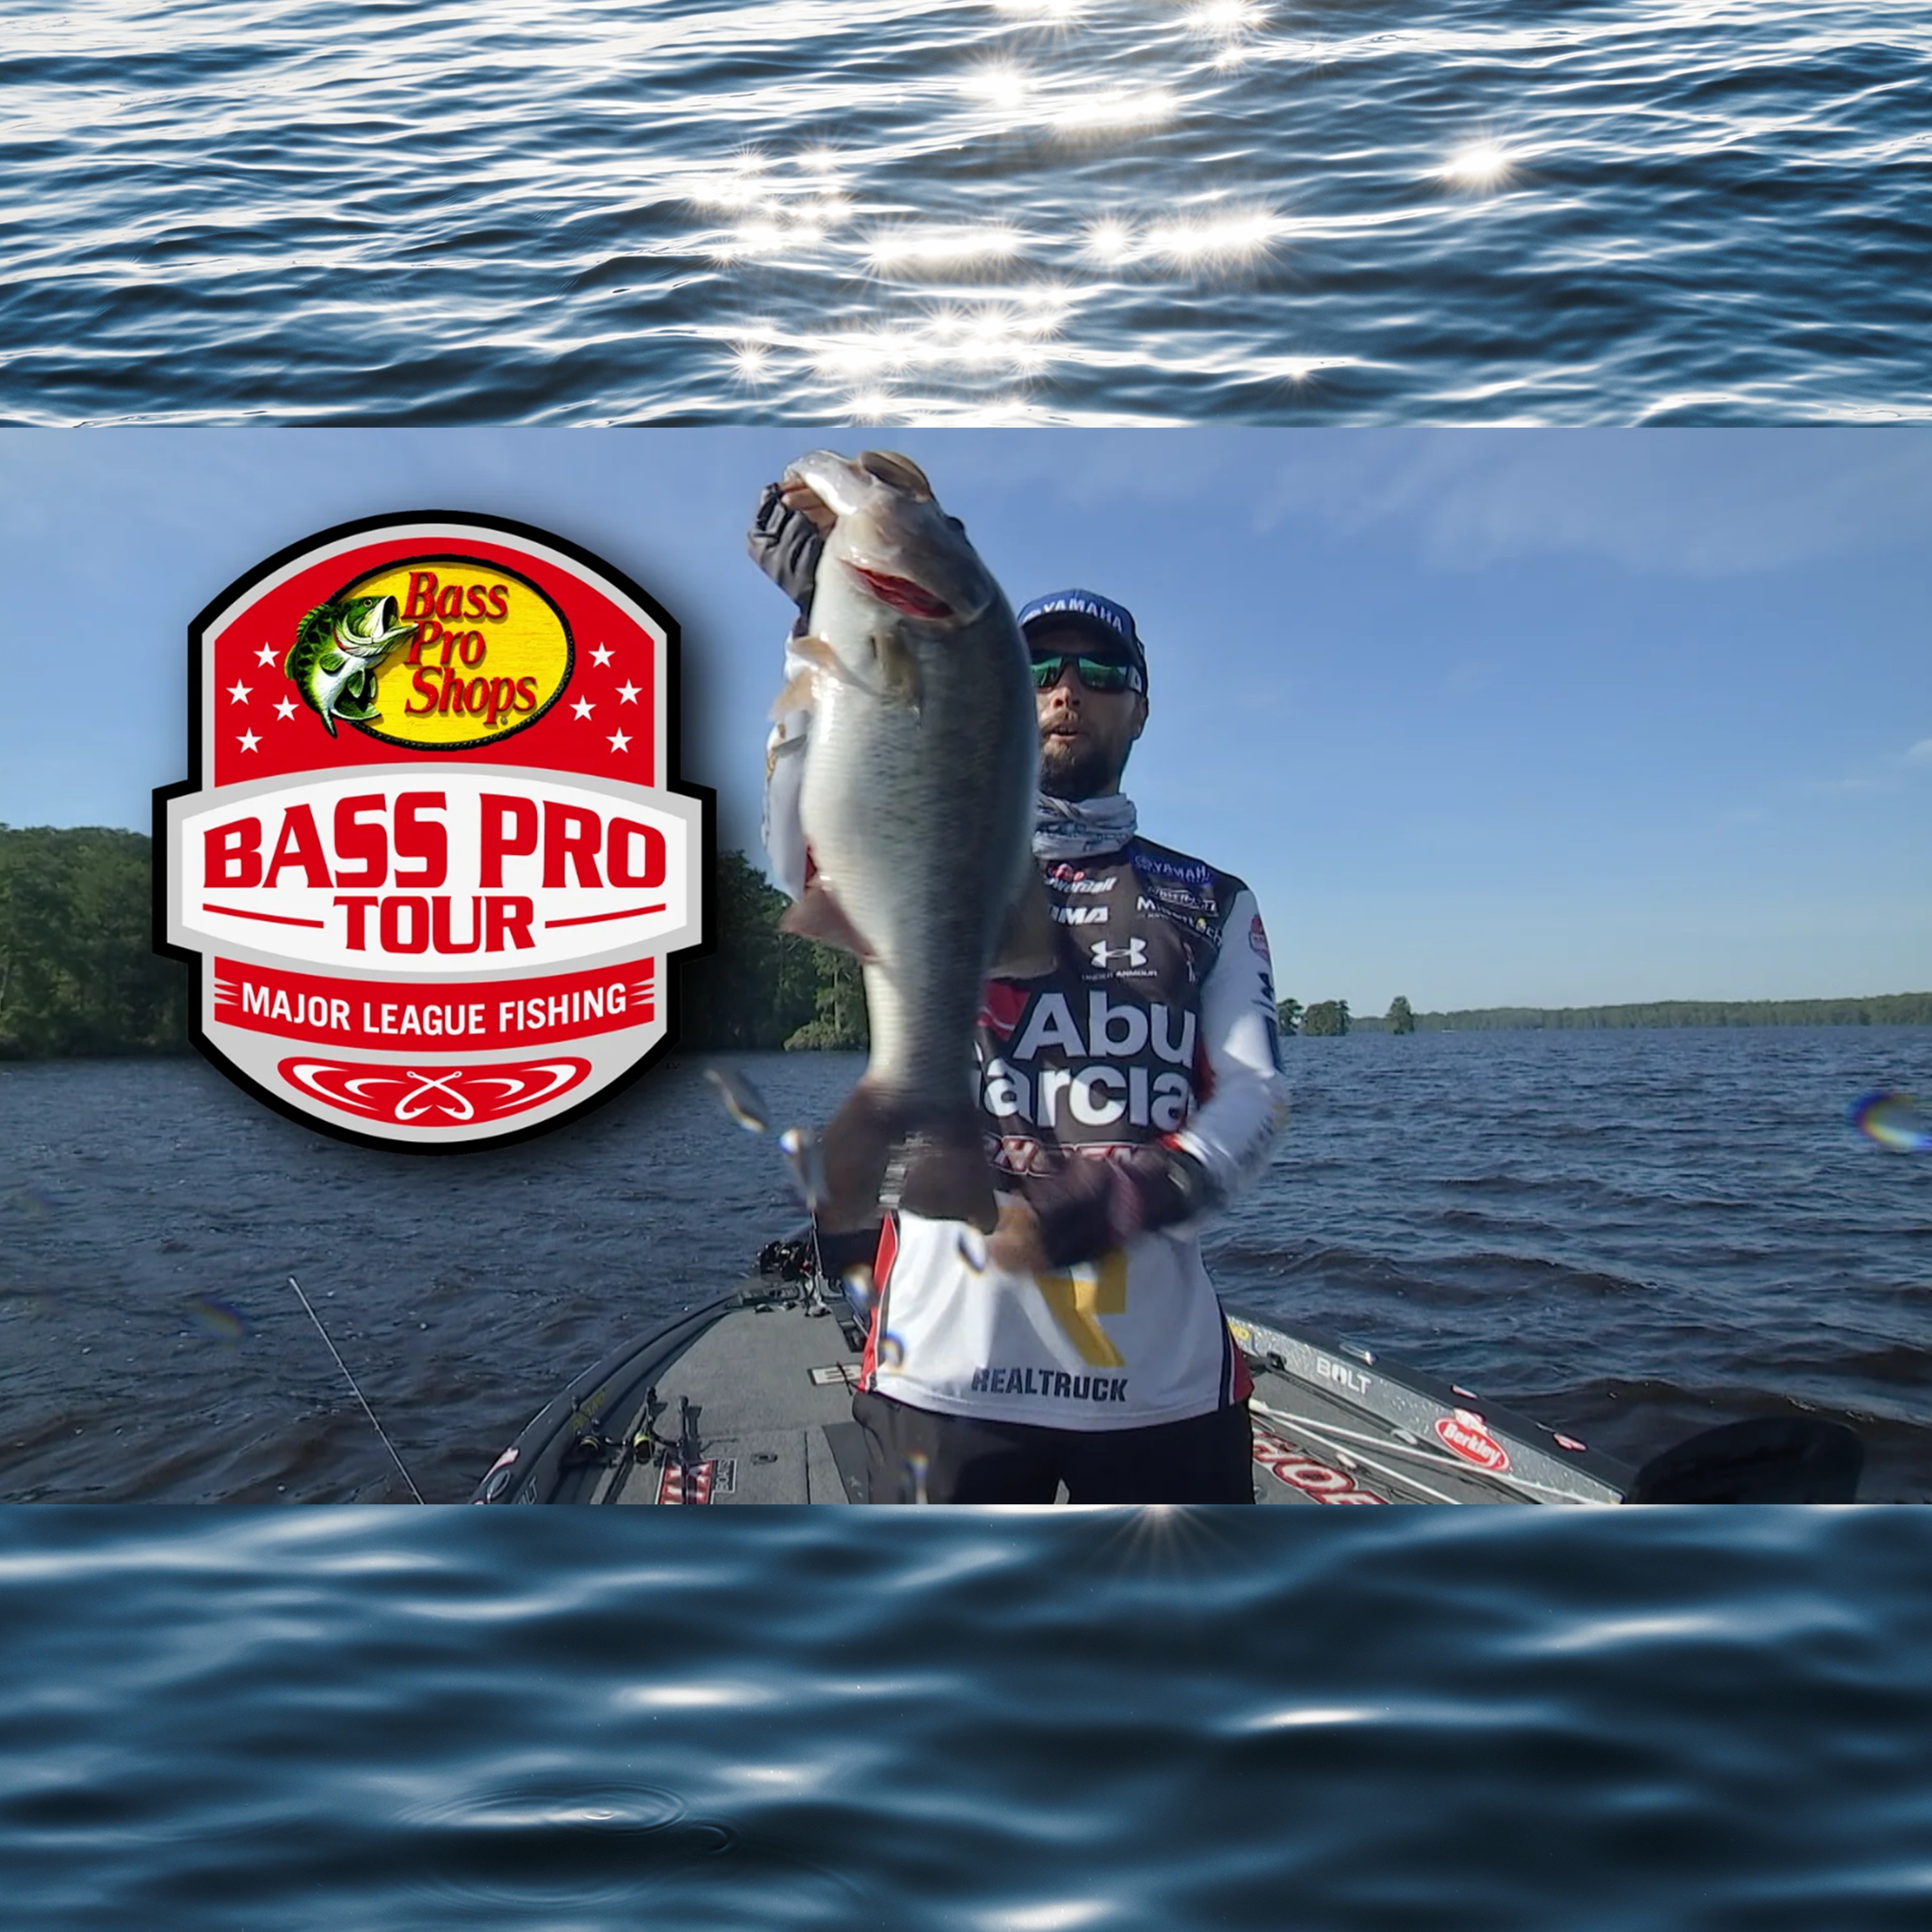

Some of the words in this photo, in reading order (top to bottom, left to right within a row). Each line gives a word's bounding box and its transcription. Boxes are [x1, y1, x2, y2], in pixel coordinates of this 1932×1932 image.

[1043, 598, 1122, 633] YAMAHA
[1012, 990, 1196, 1067] Abu
[974, 1057, 1190, 1132] arcia
[971, 1367, 1128, 1402] REALTRUCK
[1316, 1356, 1372, 1395] BOLT
[1443, 1422, 1501, 1466] Berkley
